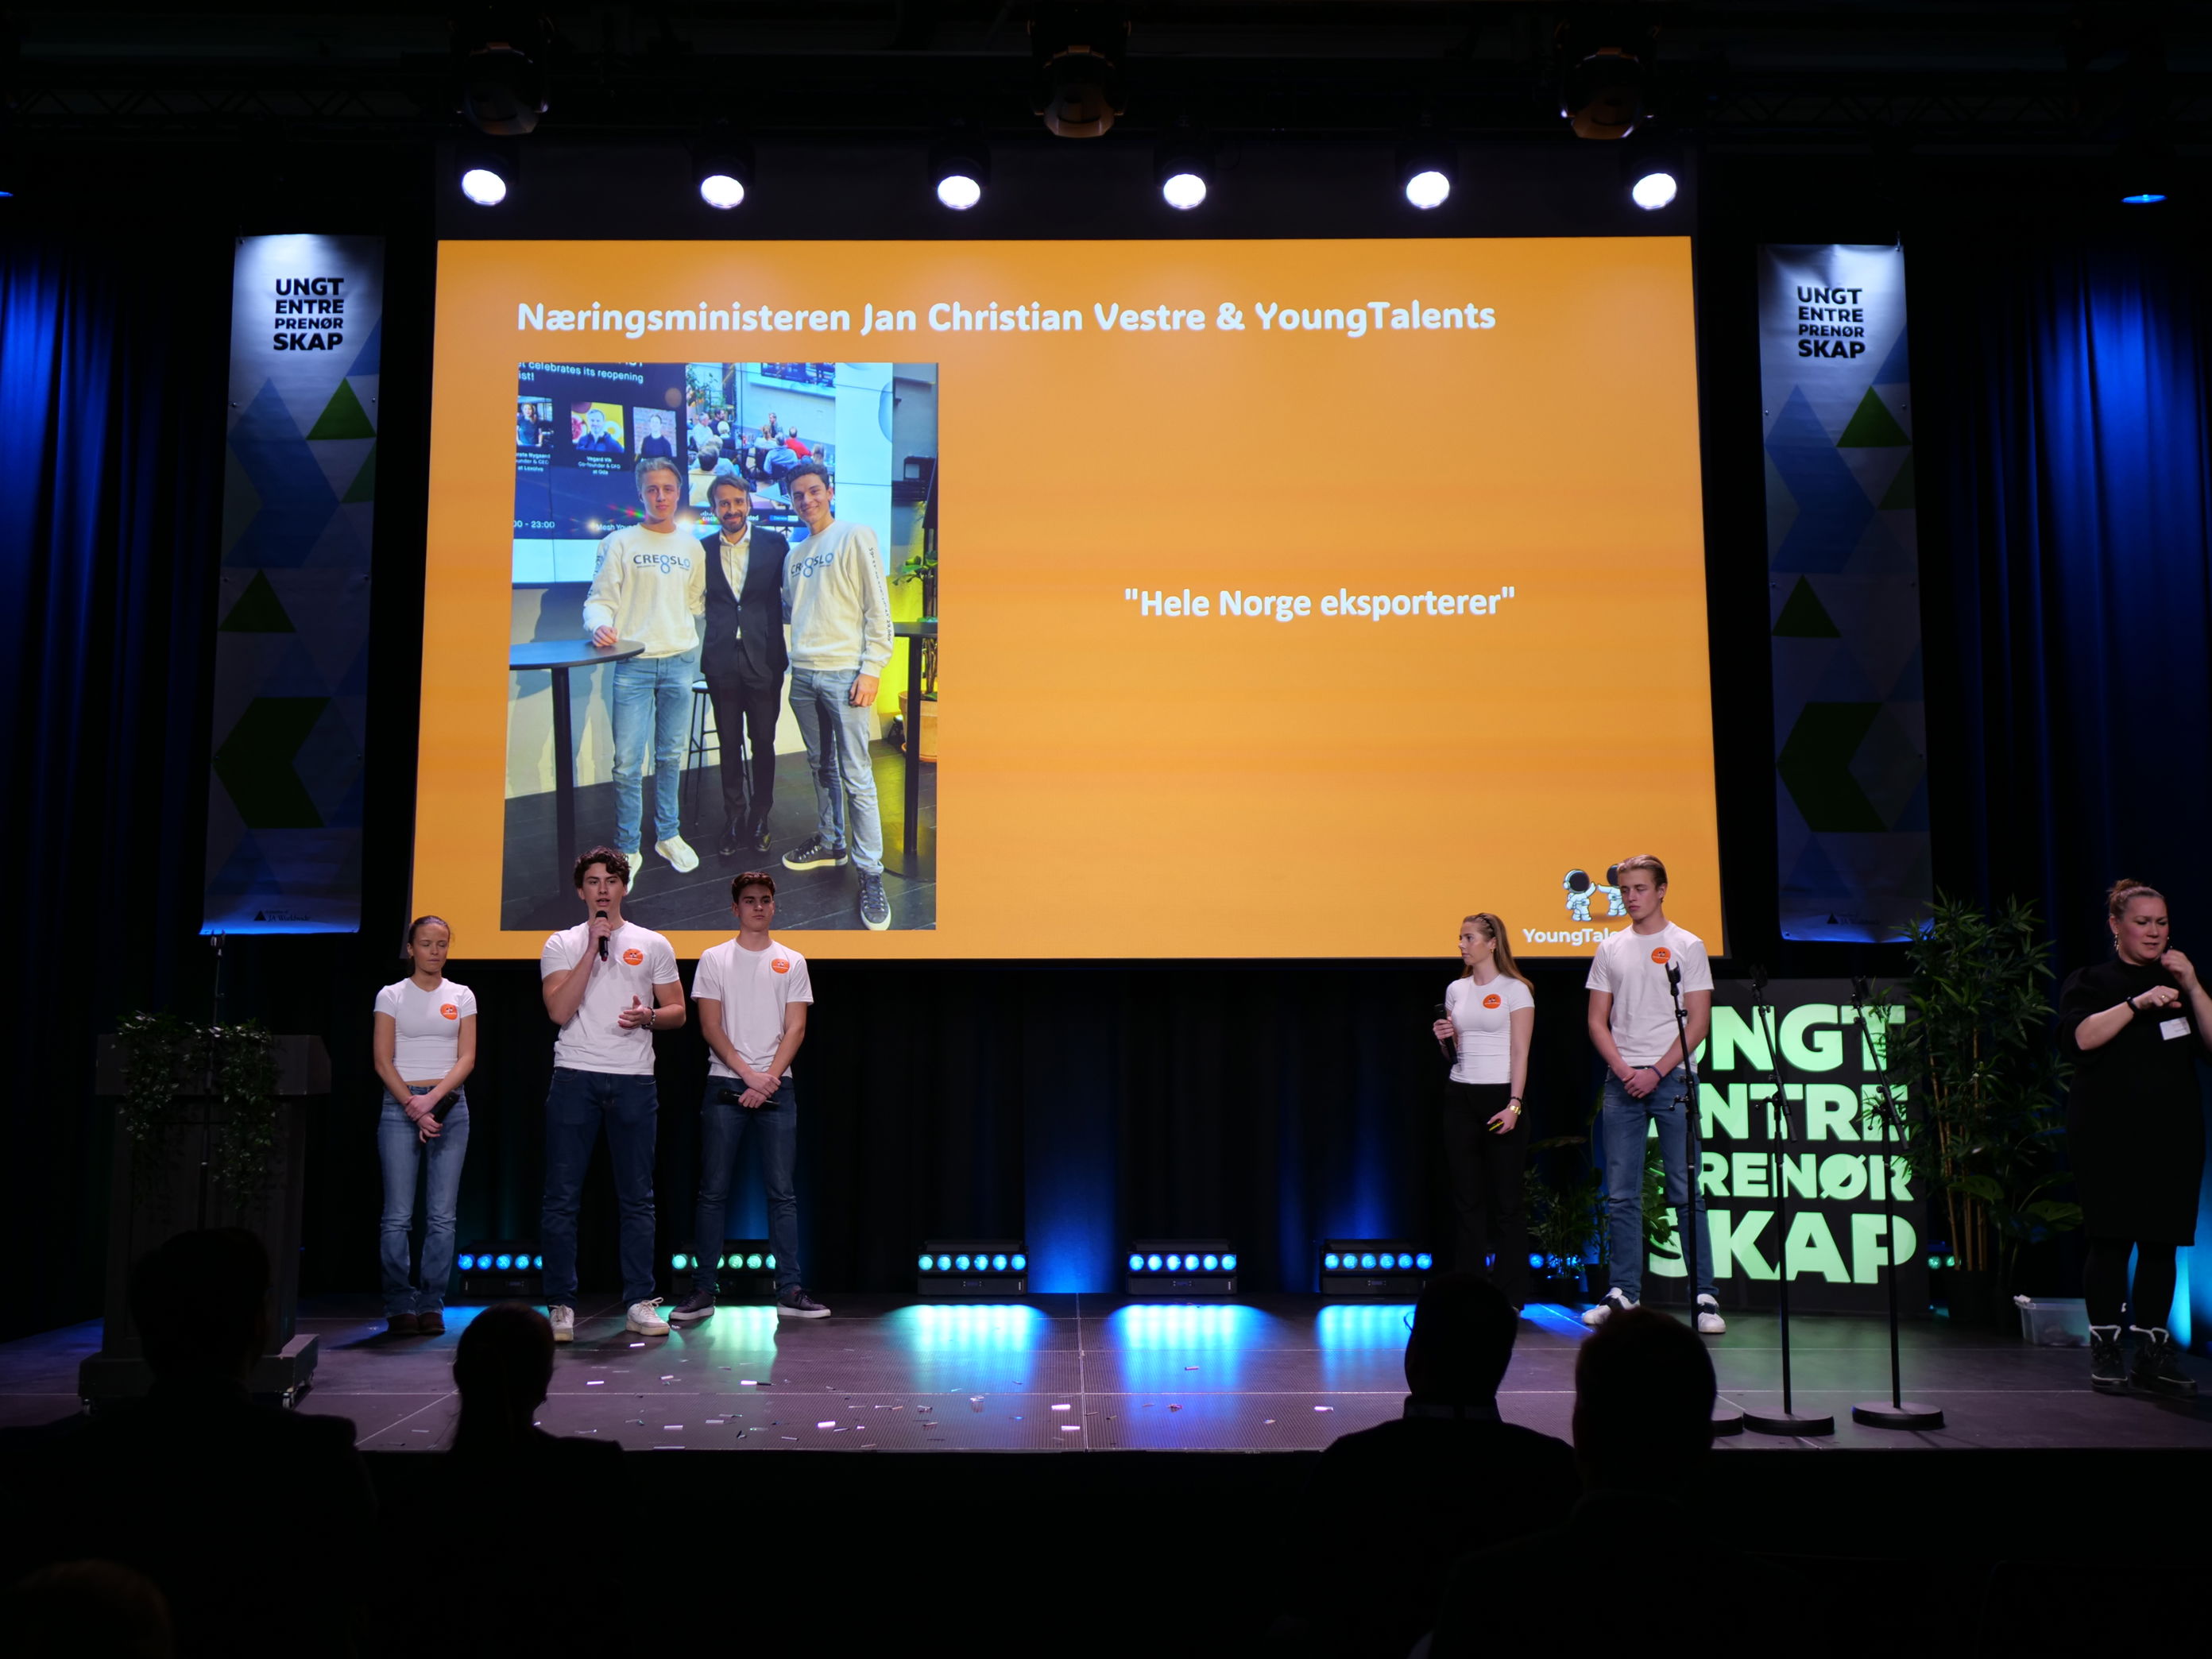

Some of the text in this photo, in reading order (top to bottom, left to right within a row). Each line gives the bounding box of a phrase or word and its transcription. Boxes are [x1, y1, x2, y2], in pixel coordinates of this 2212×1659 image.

[276, 277, 344, 296] UNGT
[1797, 286, 1862, 304] UNGT
[275, 299, 344, 315] ENTRE
[1797, 305, 1864, 323] ENTRE
[274, 317, 343, 330] PRENØR
[517, 299, 1496, 340] Næringsministeren Jan Christian Vestre & YoungTalents
[1798, 323, 1865, 337] PRENØR
[273, 332, 343, 351] SKAP
[1798, 339, 1866, 358] SKAP
[583, 367, 596, 377] its
[597, 369, 644, 385] reopening
[531, 520, 555, 529] 23:00
[1124, 586, 1515, 623] "Hele Norge eksporterer"
[1696, 1003, 1906, 1073] NGT
[1648, 1082, 1910, 1143] NTRE
[1648, 1151, 1915, 1201] RENØR
